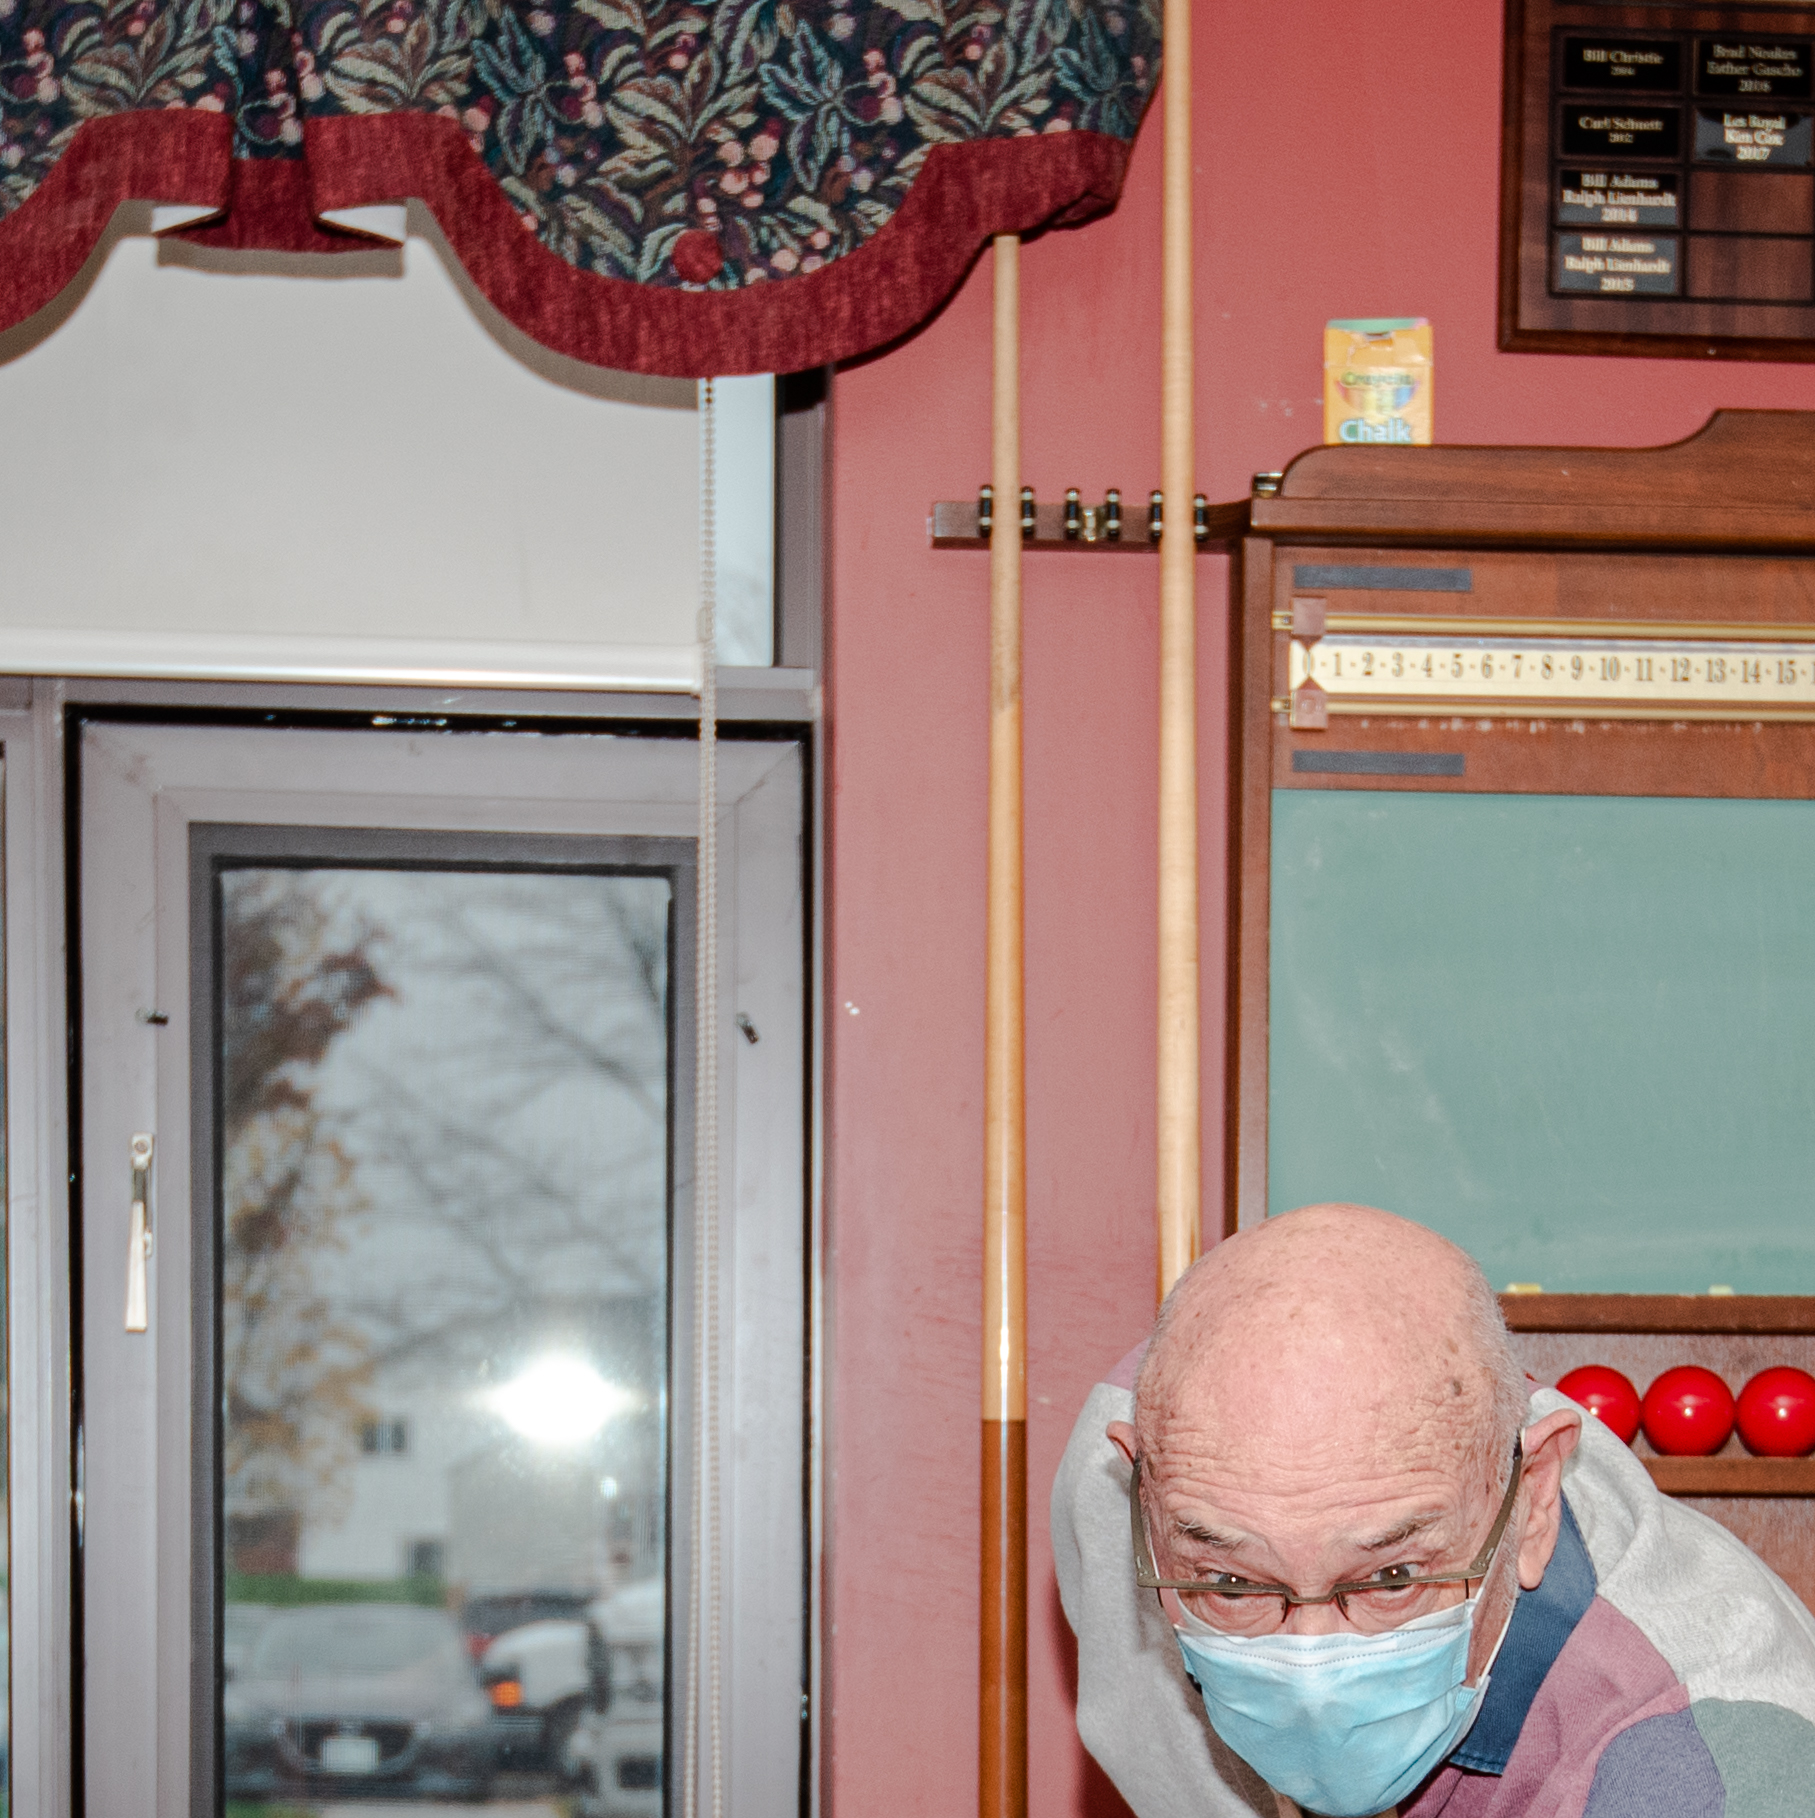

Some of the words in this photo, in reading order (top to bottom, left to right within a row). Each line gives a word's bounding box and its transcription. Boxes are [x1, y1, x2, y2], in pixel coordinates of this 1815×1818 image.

[1583, 49, 1607, 62] Bill
[1713, 44, 1746, 59] Brad
[1578, 116, 1611, 129] Carl
[1749, 114, 1786, 132] Royal
[1737, 146, 1771, 160] 2017
[1581, 174, 1607, 187] Bill
[1610, 175, 1659, 189] Adams
[1563, 189, 1606, 208] Ralph
[1582, 236, 1608, 251] Bill
[1608, 238, 1656, 254] Adams
[1565, 255, 1605, 274] Ralph
[1601, 277, 1635, 291] 2015
[1339, 418, 1412, 442] Chalk
[1333, 652, 1342, 678] 1
[1362, 652, 1374, 678] 2
[1392, 652, 1404, 678] 3
[1421, 653, 1433, 679] 4
[1451, 653, 1463, 679] 5
[1481, 653, 1493, 680] 6
[1511, 654, 1522, 680] 7
[1542, 654, 1553, 681] 8
[1571, 655, 1583, 681] 9
[1600, 656, 1621, 682] 10
[1636, 656, 1653, 683] 11
[1671, 657, 1691, 684] 12
[1706, 657, 1726, 684] 13
[1741, 659, 1761, 685] 14
[1777, 659, 1796, 686] 15
